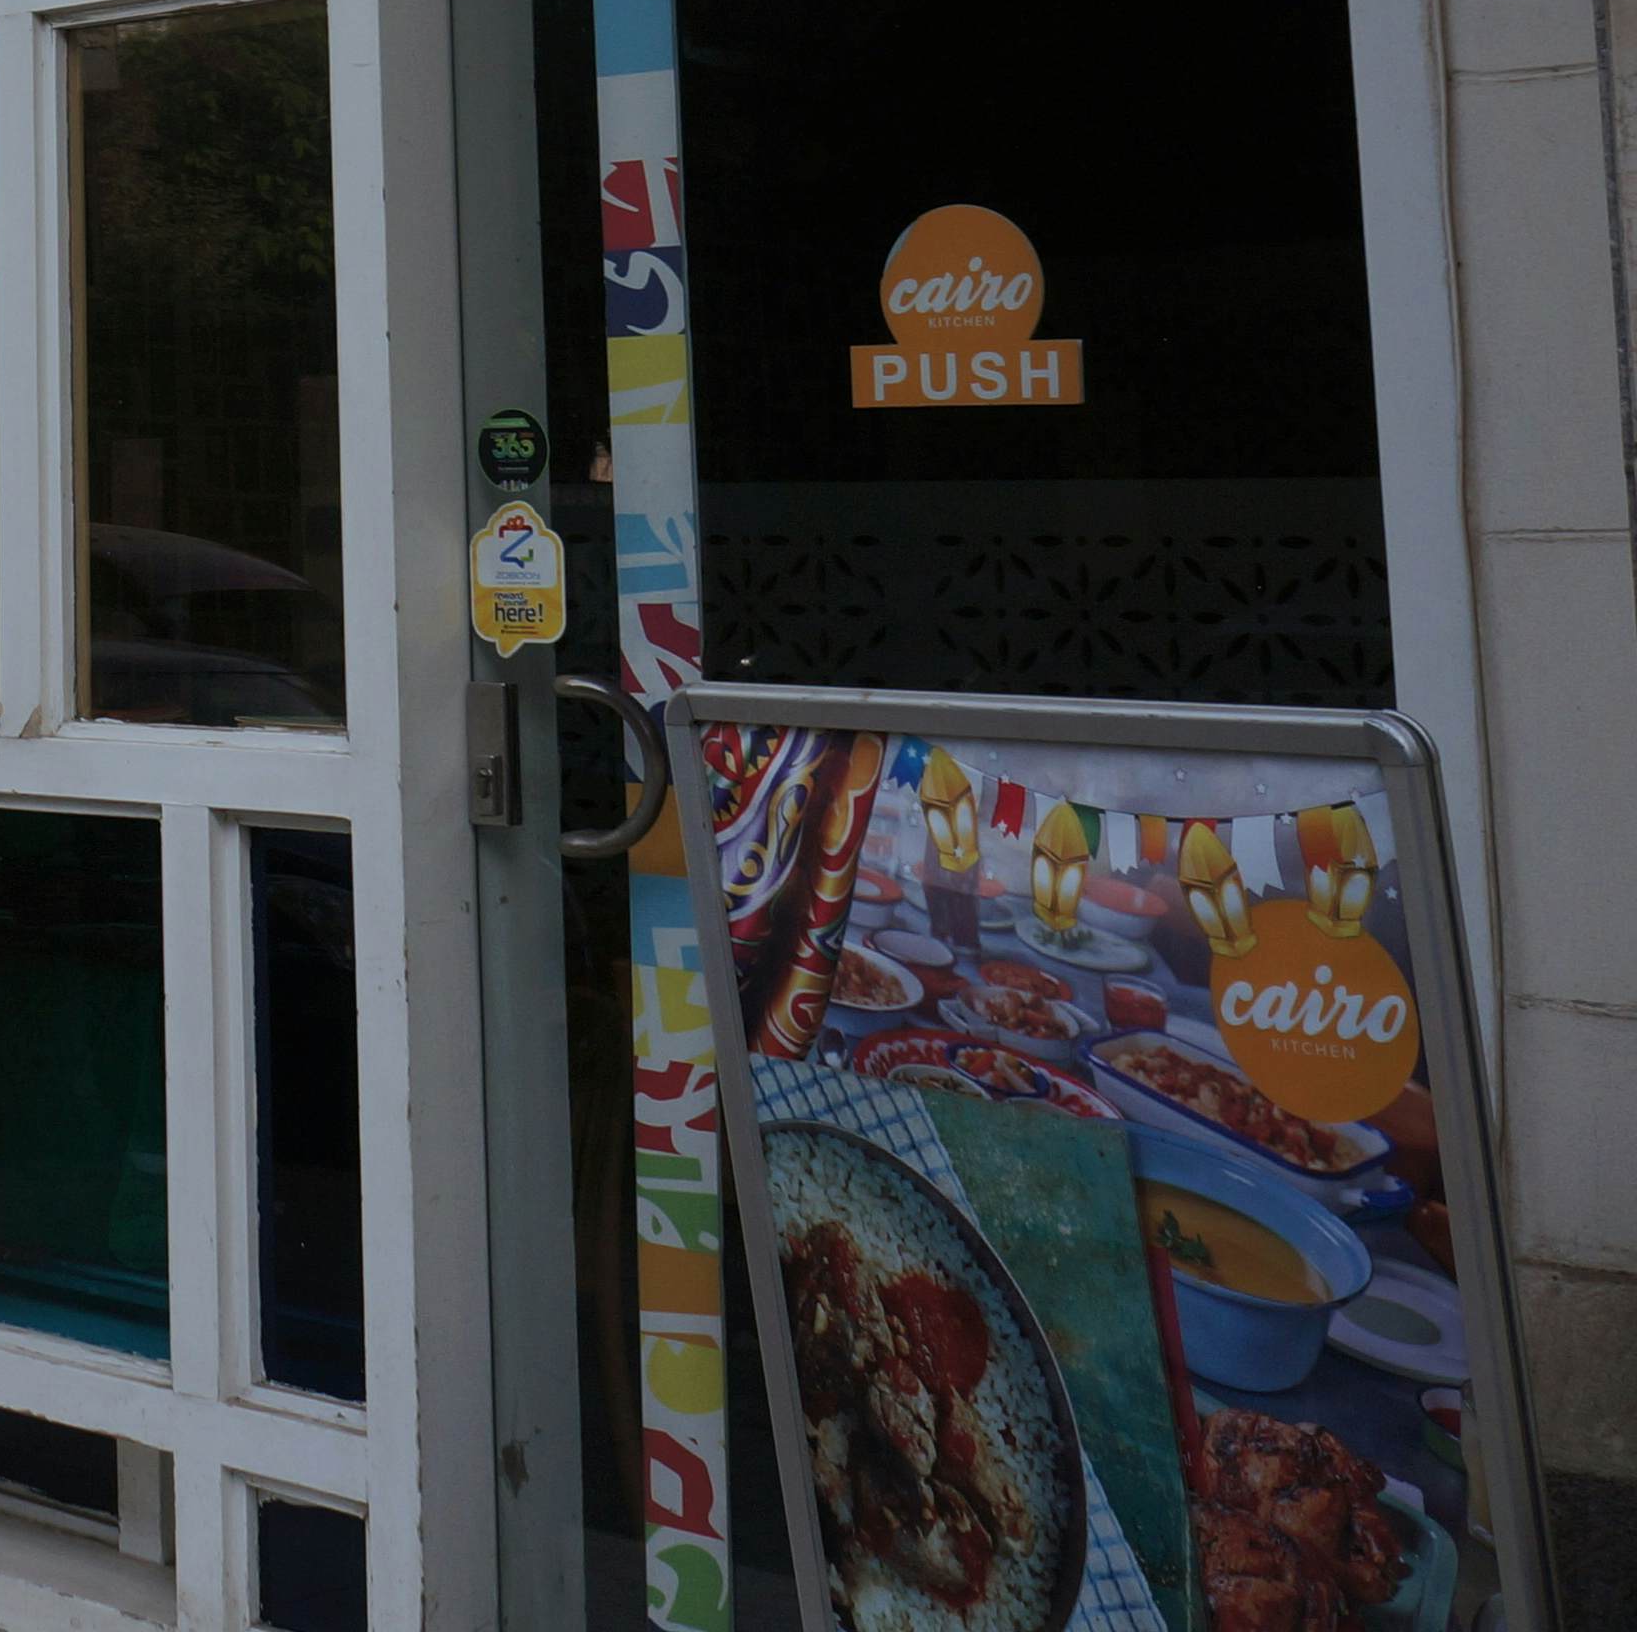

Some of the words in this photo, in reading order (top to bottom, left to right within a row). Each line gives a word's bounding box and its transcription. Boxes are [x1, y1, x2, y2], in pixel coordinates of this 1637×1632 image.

[888, 256, 1033, 314] cairo
[928, 315, 995, 329] KITCHEN
[872, 350, 1060, 401] PUSH
[494, 601, 544, 623] here!
[1220, 965, 1407, 1044] cairo
[1269, 1038, 1357, 1060] KITCHEN
